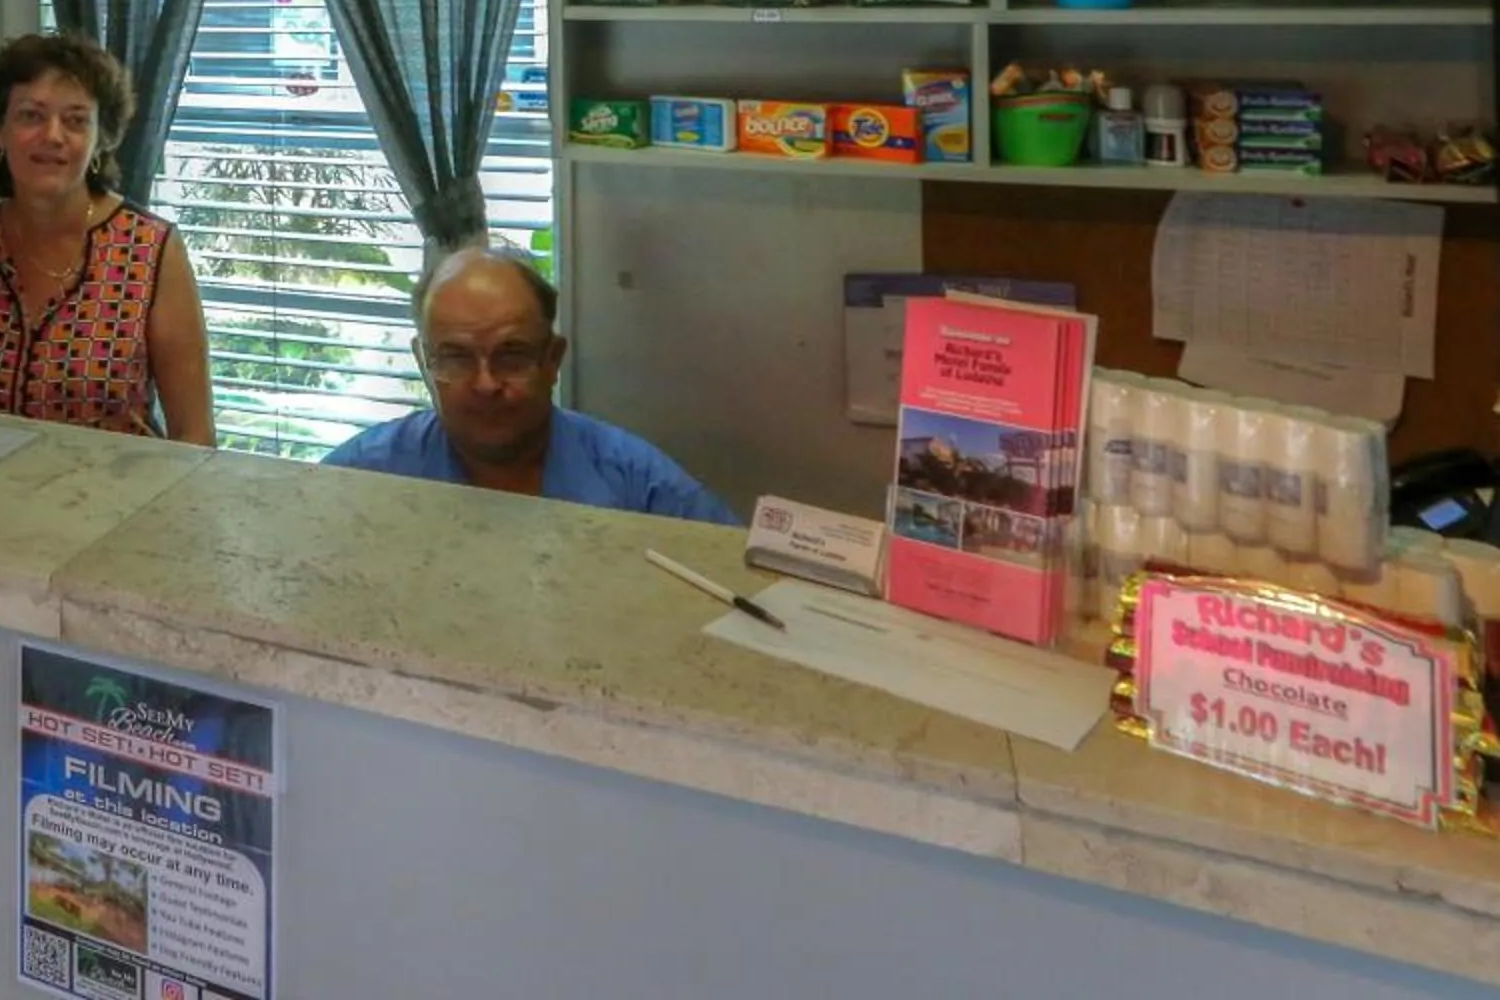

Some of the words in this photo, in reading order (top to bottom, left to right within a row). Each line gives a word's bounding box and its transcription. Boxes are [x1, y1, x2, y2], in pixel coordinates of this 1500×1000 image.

[852, 116, 888, 139] Tide
[1197, 594, 1386, 667] Richard's
[1223, 667, 1349, 712] Chocolate
[27, 711, 73, 734] HOT
[81, 725, 134, 755] SET!
[148, 745, 198, 771] HOT
[207, 762, 264, 790] SET!
[1190, 691, 1278, 743] $1.00
[1289, 719, 1387, 776] Each!
[63, 755, 223, 822] FILMING
[63, 788, 86, 803] at
[93, 796, 134, 820] this
[140, 807, 224, 846] location
[31, 813, 84, 842] Filming
[86, 832, 116, 854] may
[120, 844, 162, 867] occur
[165, 858, 180, 873] at
[184, 862, 211, 885] any
[215, 871, 255, 897] time.
